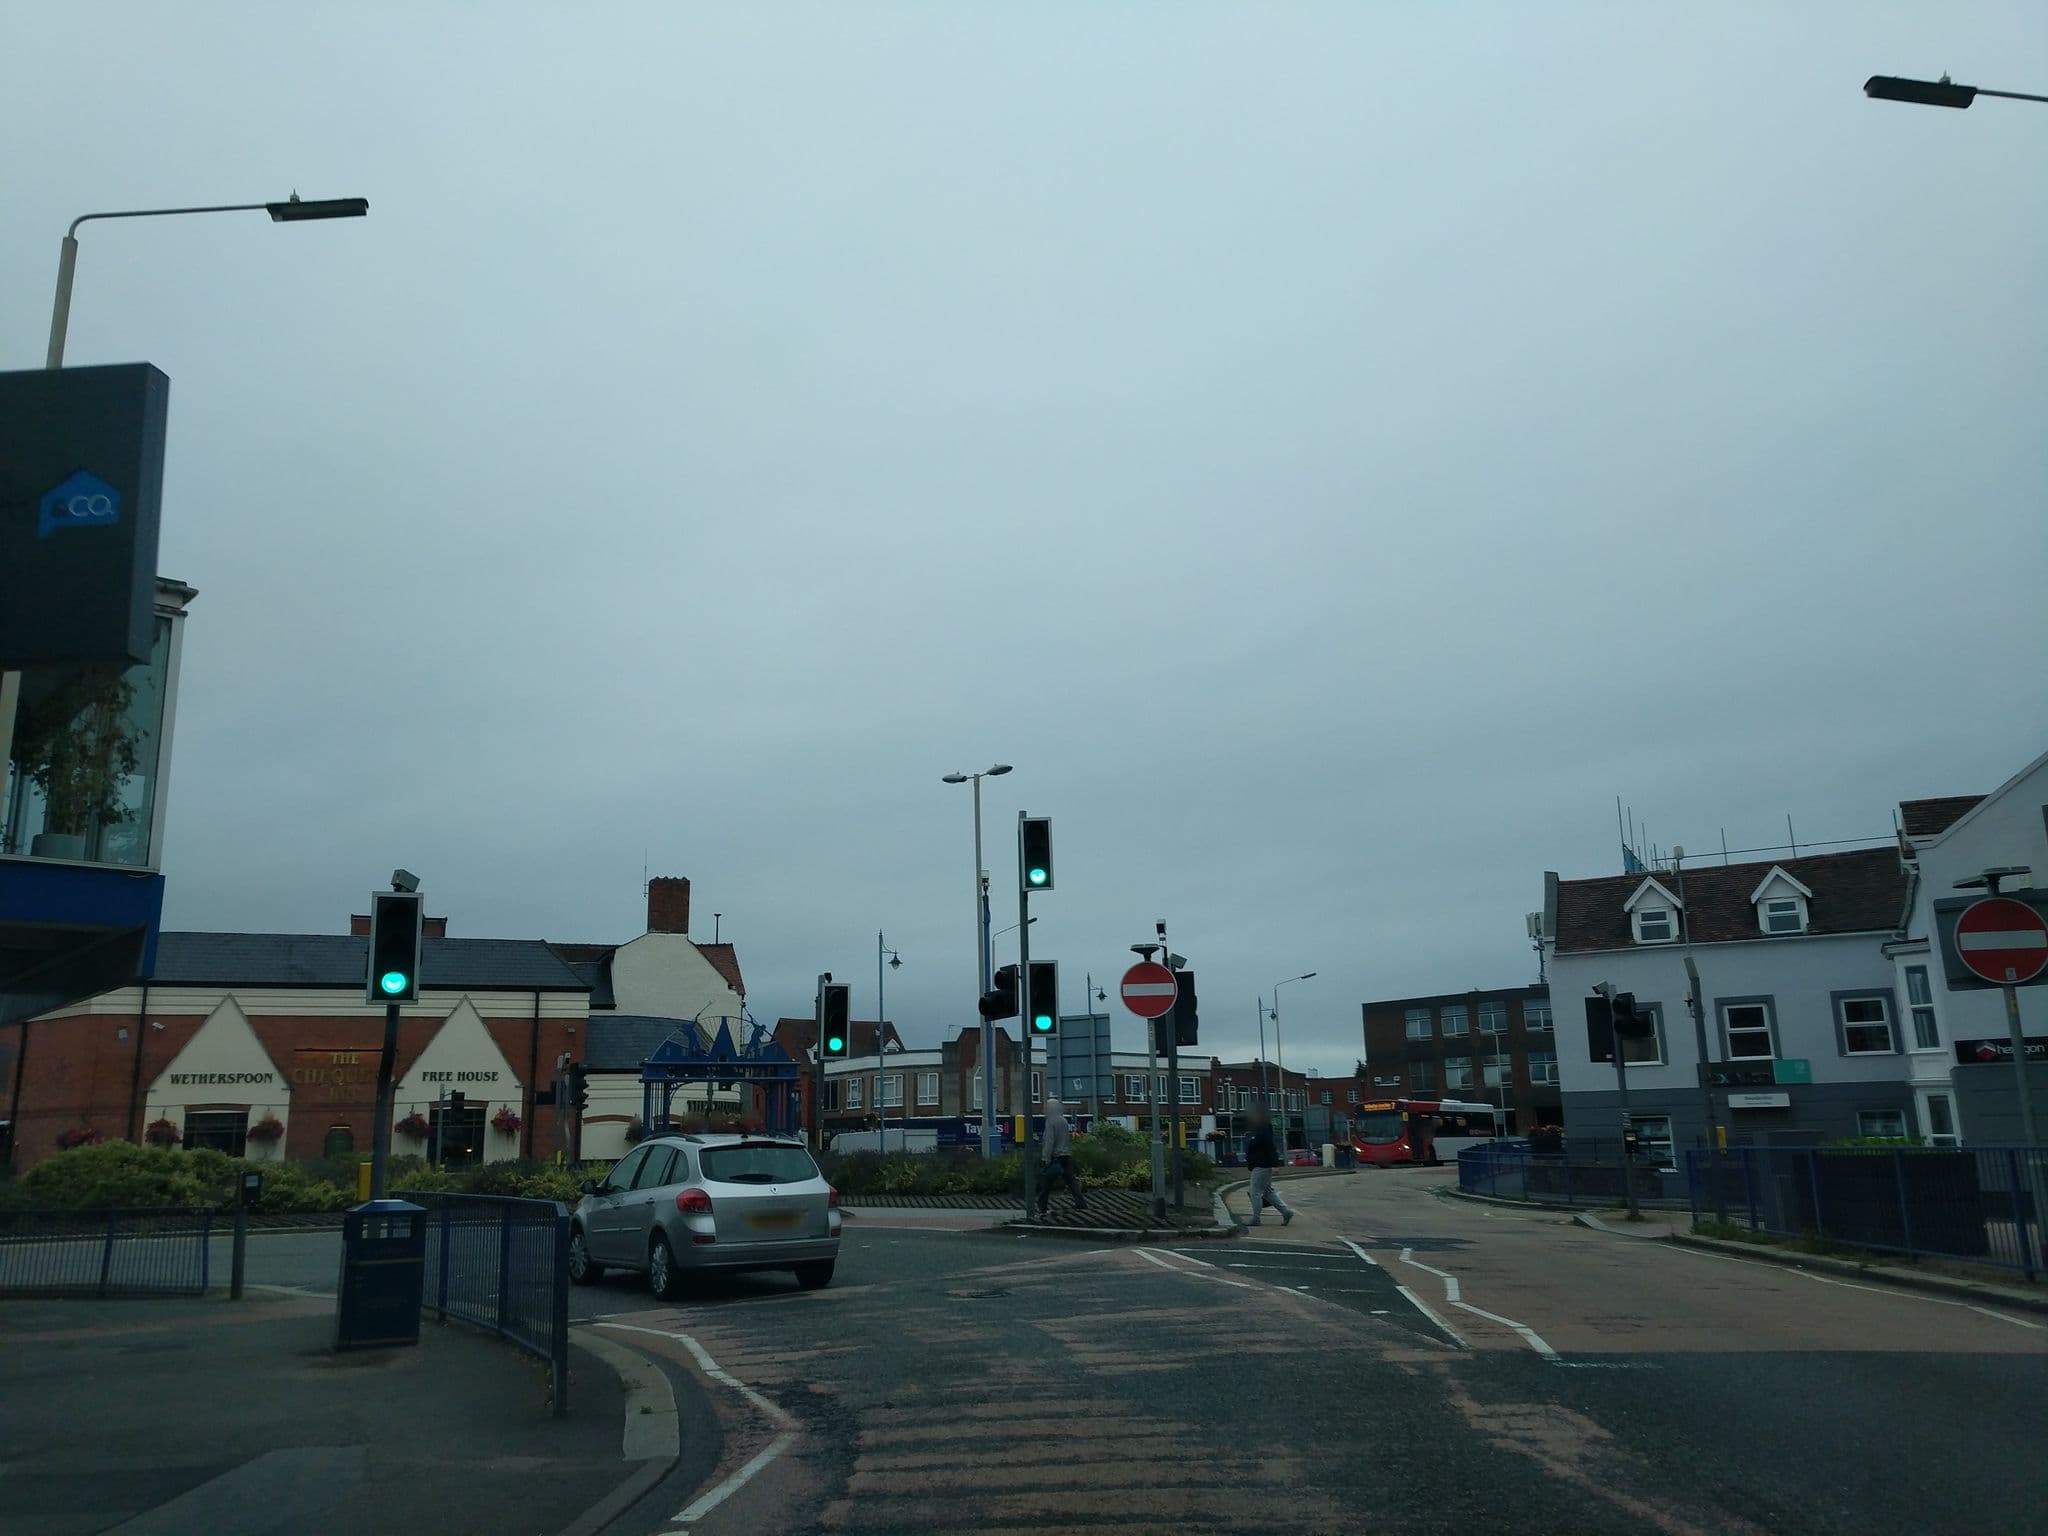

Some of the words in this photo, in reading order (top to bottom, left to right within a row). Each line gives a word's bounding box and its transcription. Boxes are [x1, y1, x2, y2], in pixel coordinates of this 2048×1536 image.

[332, 1053, 360, 1065] THE
[170, 1073, 273, 1085] WETHERSPOON
[422, 1071, 453, 1082] FREE
[457, 1071, 499, 1082] HOUSE
[964, 1122, 1005, 1136] Tays
